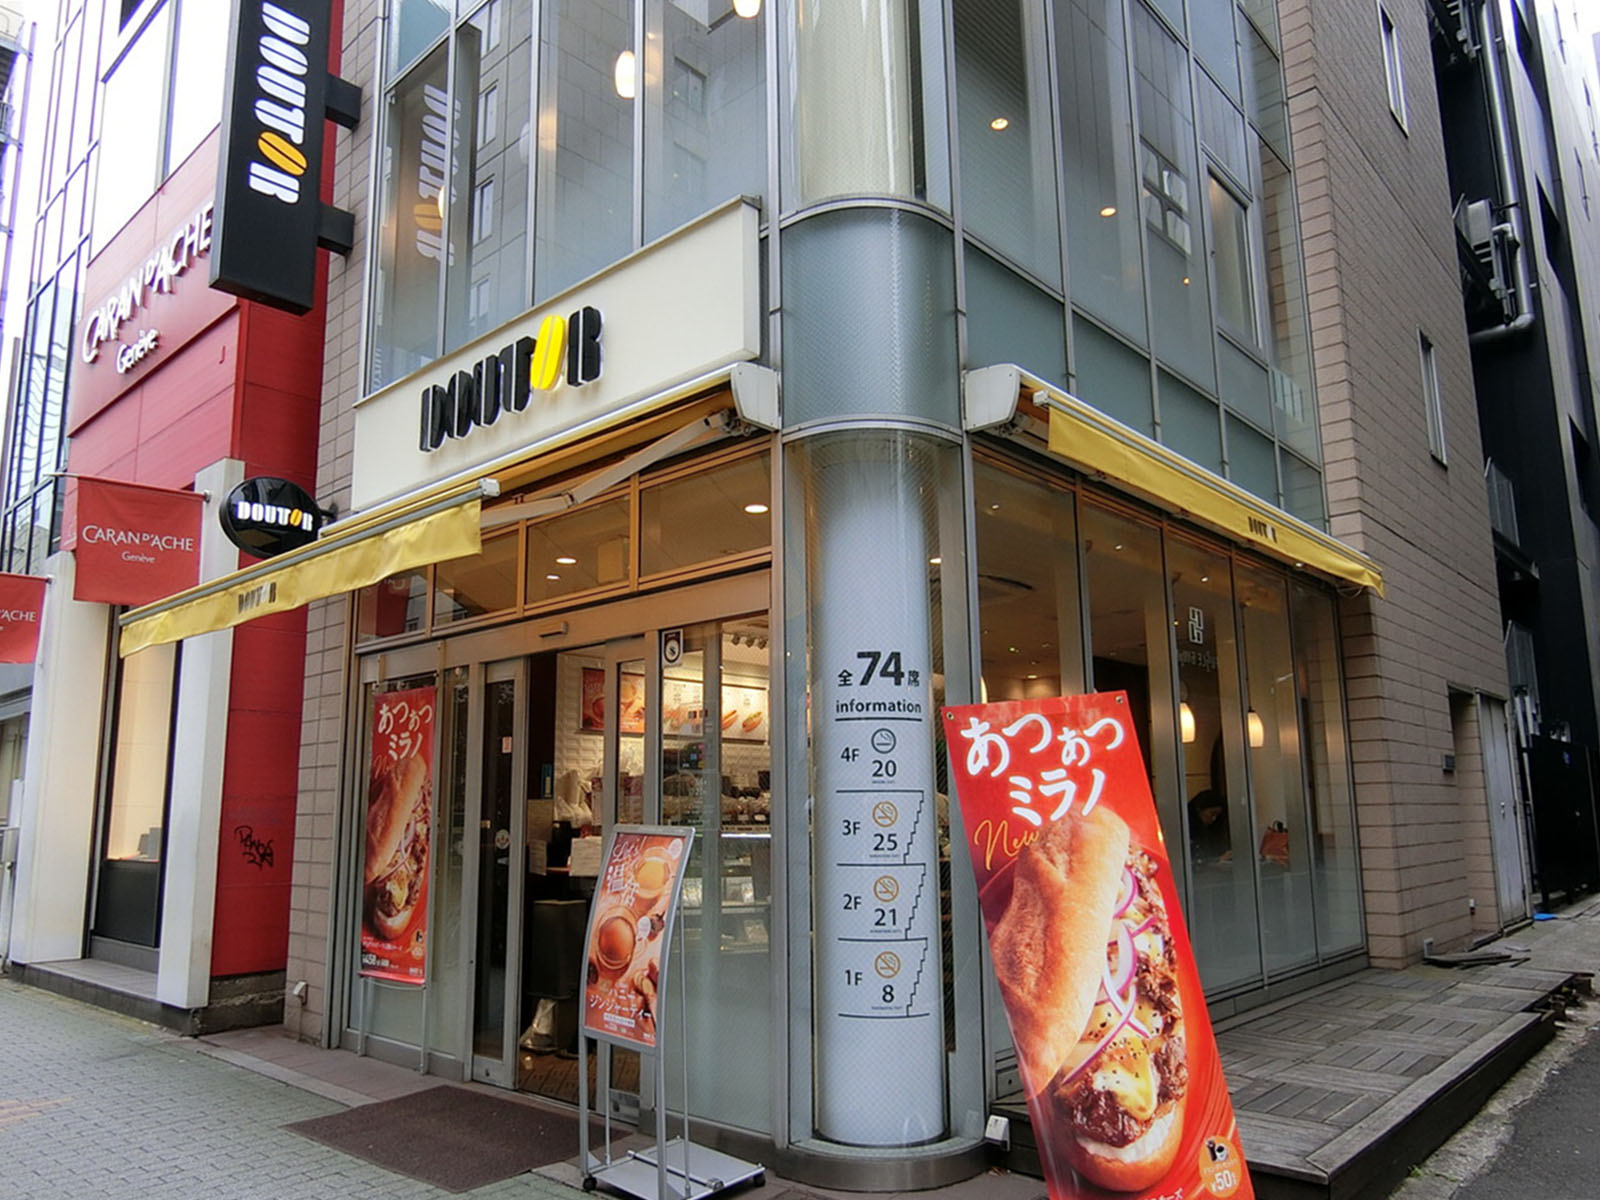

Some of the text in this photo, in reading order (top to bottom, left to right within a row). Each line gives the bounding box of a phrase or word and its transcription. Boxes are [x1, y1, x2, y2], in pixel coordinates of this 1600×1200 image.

[248, 1, 310, 204] DOUTOR
[82, 267, 145, 364] CARAN
[419, 306, 604, 453] DOUTOR
[237, 501, 313, 531] DOUTOR
[82, 524, 194, 552] CARAN D'ACHE
[835, 699, 922, 713] information
[388, 731, 423, 761] ミラノ
[840, 747, 860, 763] 4F
[871, 759, 897, 778] 20
[1008, 768, 1106, 826] ミラノ
[842, 819, 861, 836] 3F
[873, 833, 898, 852] 25
[974, 819, 1039, 871] New
[842, 893, 862, 911] 2F
[874, 908, 897, 926] 21
[844, 969, 863, 986] 1F
[881, 984, 895, 1004] 8
